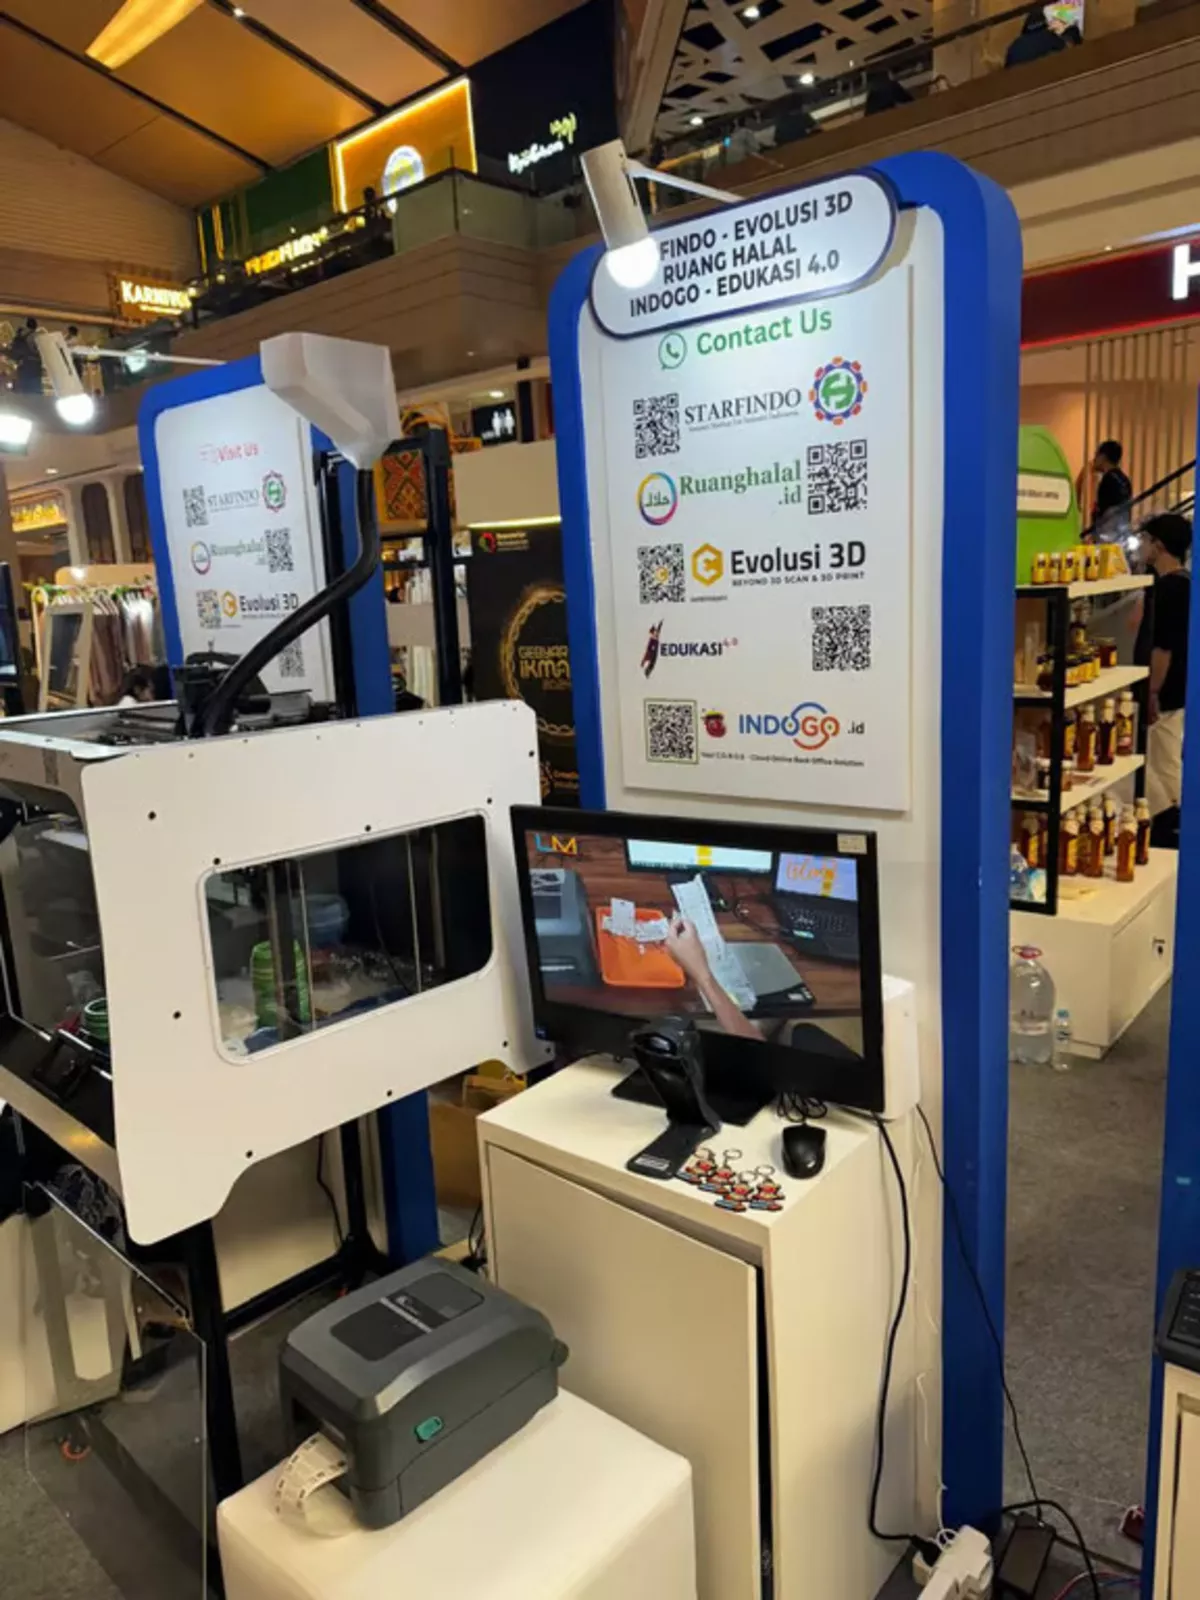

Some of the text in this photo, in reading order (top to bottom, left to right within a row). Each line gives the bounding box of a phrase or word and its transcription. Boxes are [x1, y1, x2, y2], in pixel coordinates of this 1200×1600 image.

[660, 229, 716, 260] FINDO
[734, 200, 818, 241] EVOLUSI
[824, 191, 853, 216] 3D
[664, 234, 796, 285] RUANG HALAL
[630, 284, 700, 317] INDOGO
[717, 260, 801, 297] EDUKASI
[807, 250, 840, 275] 4.0
[697, 308, 833, 355] Contact Us
[684, 388, 802, 425] STARFINDO
[680, 459, 801, 497] Ruanghalal
[778, 485, 801, 505] .id
[731, 541, 866, 575] Evolusi 3D
[732, 577, 767, 587] BEYOND
[784, 575, 809, 584] SCAN
[836, 571, 865, 580] PRINT
[239, 592, 299, 612] Evolusi 3D
[660, 641, 723, 657] EDUKASI
[739, 702, 865, 751] INDOGO .id
